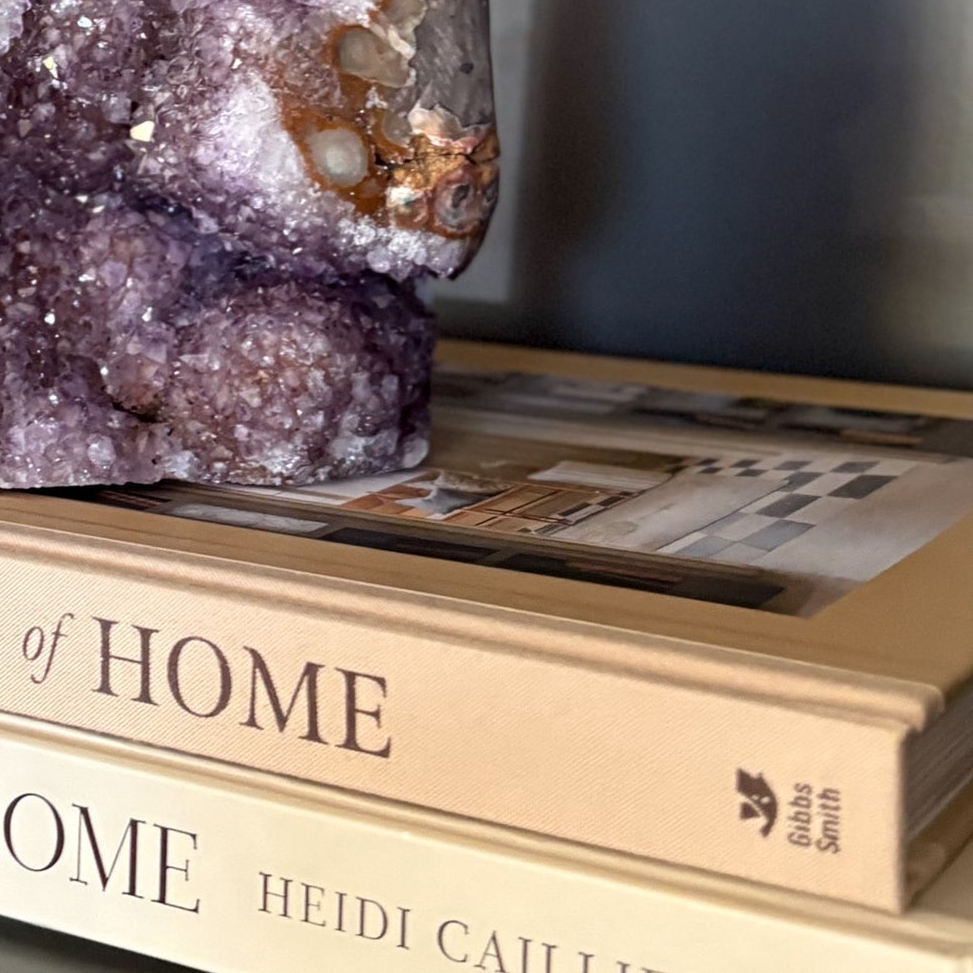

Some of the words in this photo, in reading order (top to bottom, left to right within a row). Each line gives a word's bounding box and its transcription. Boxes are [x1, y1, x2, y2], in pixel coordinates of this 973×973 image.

[22, 612, 75, 684] of
[91, 616, 392, 759] HOME
[787, 782, 812, 847] Gibbs
[815, 787, 841, 854] Smith
[257, 870, 412, 950] HEIDI
